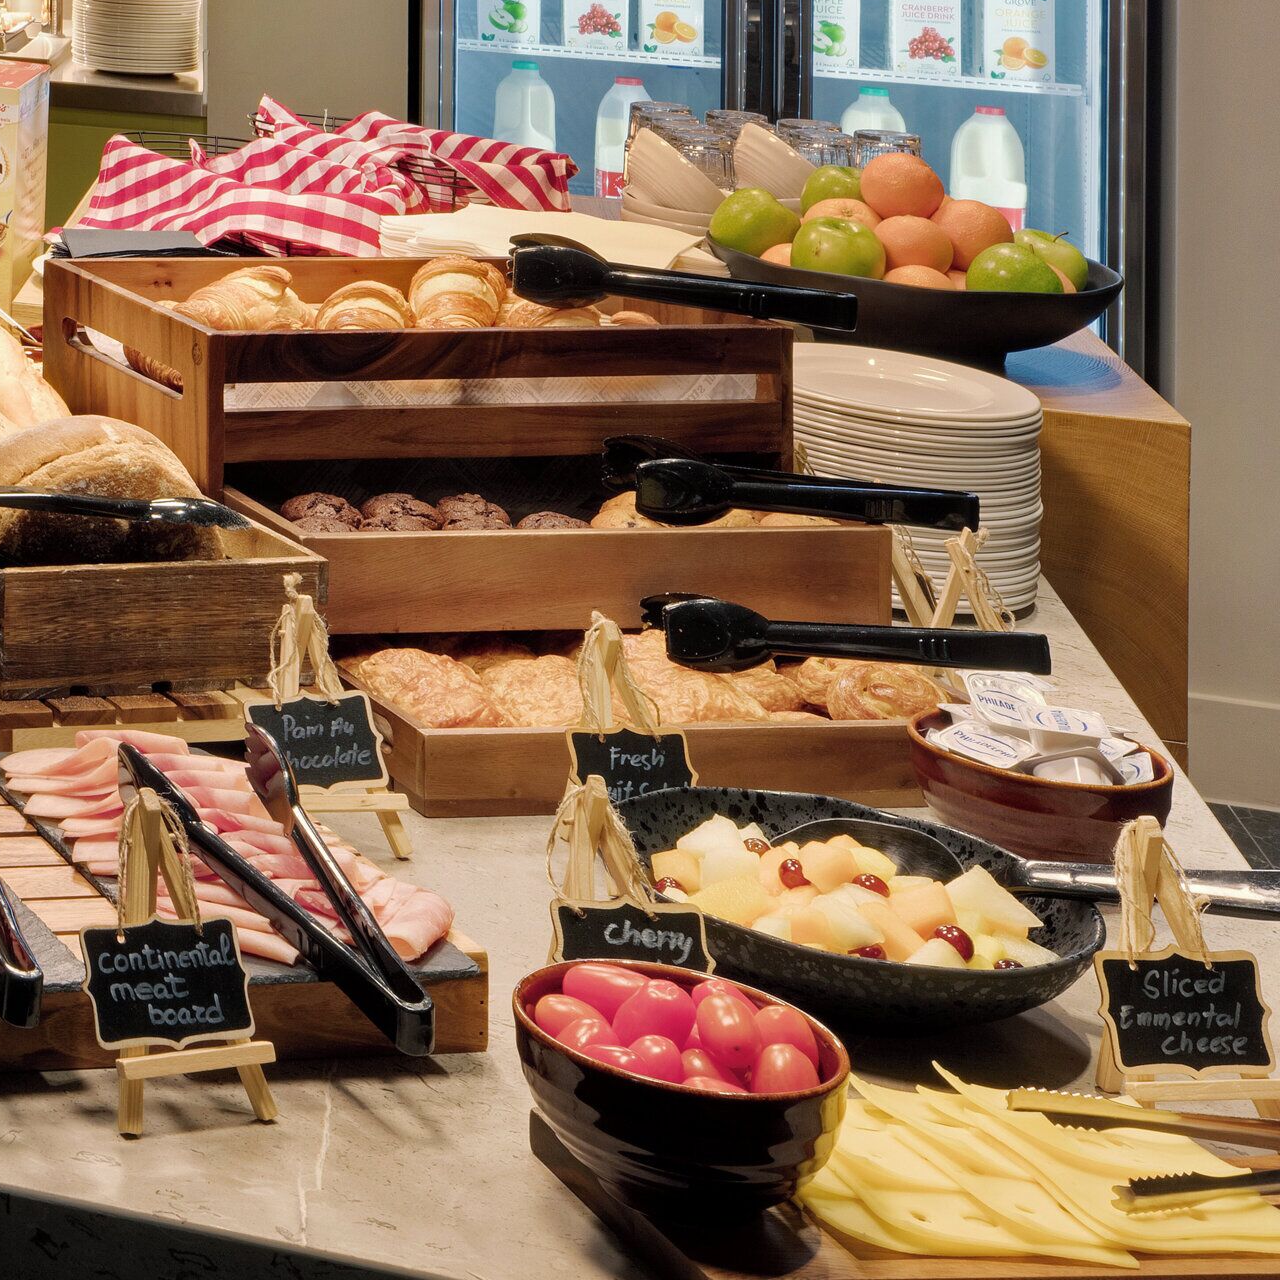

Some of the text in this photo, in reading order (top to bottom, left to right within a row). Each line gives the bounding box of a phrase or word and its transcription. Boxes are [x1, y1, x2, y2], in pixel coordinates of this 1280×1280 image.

[816, 6, 843, 14] UICE
[901, 4, 954, 13] CRANBERRY
[901, 11, 955, 20] JUICE DRINK
[995, 8, 1046, 18] ORANGE
[1005, 19, 1037, 28] JUICE
[976, 694, 1017, 712] PHILADE
[281, 714, 355, 741] Pain Au
[287, 742, 372, 770] hocolate
[609, 746, 666, 771] Fresh
[110, 972, 189, 1002] meat
[1142, 968, 1226, 1000] Sliced
[148, 993, 225, 1026] board
[1119, 1001, 1241, 1031] Emmental
